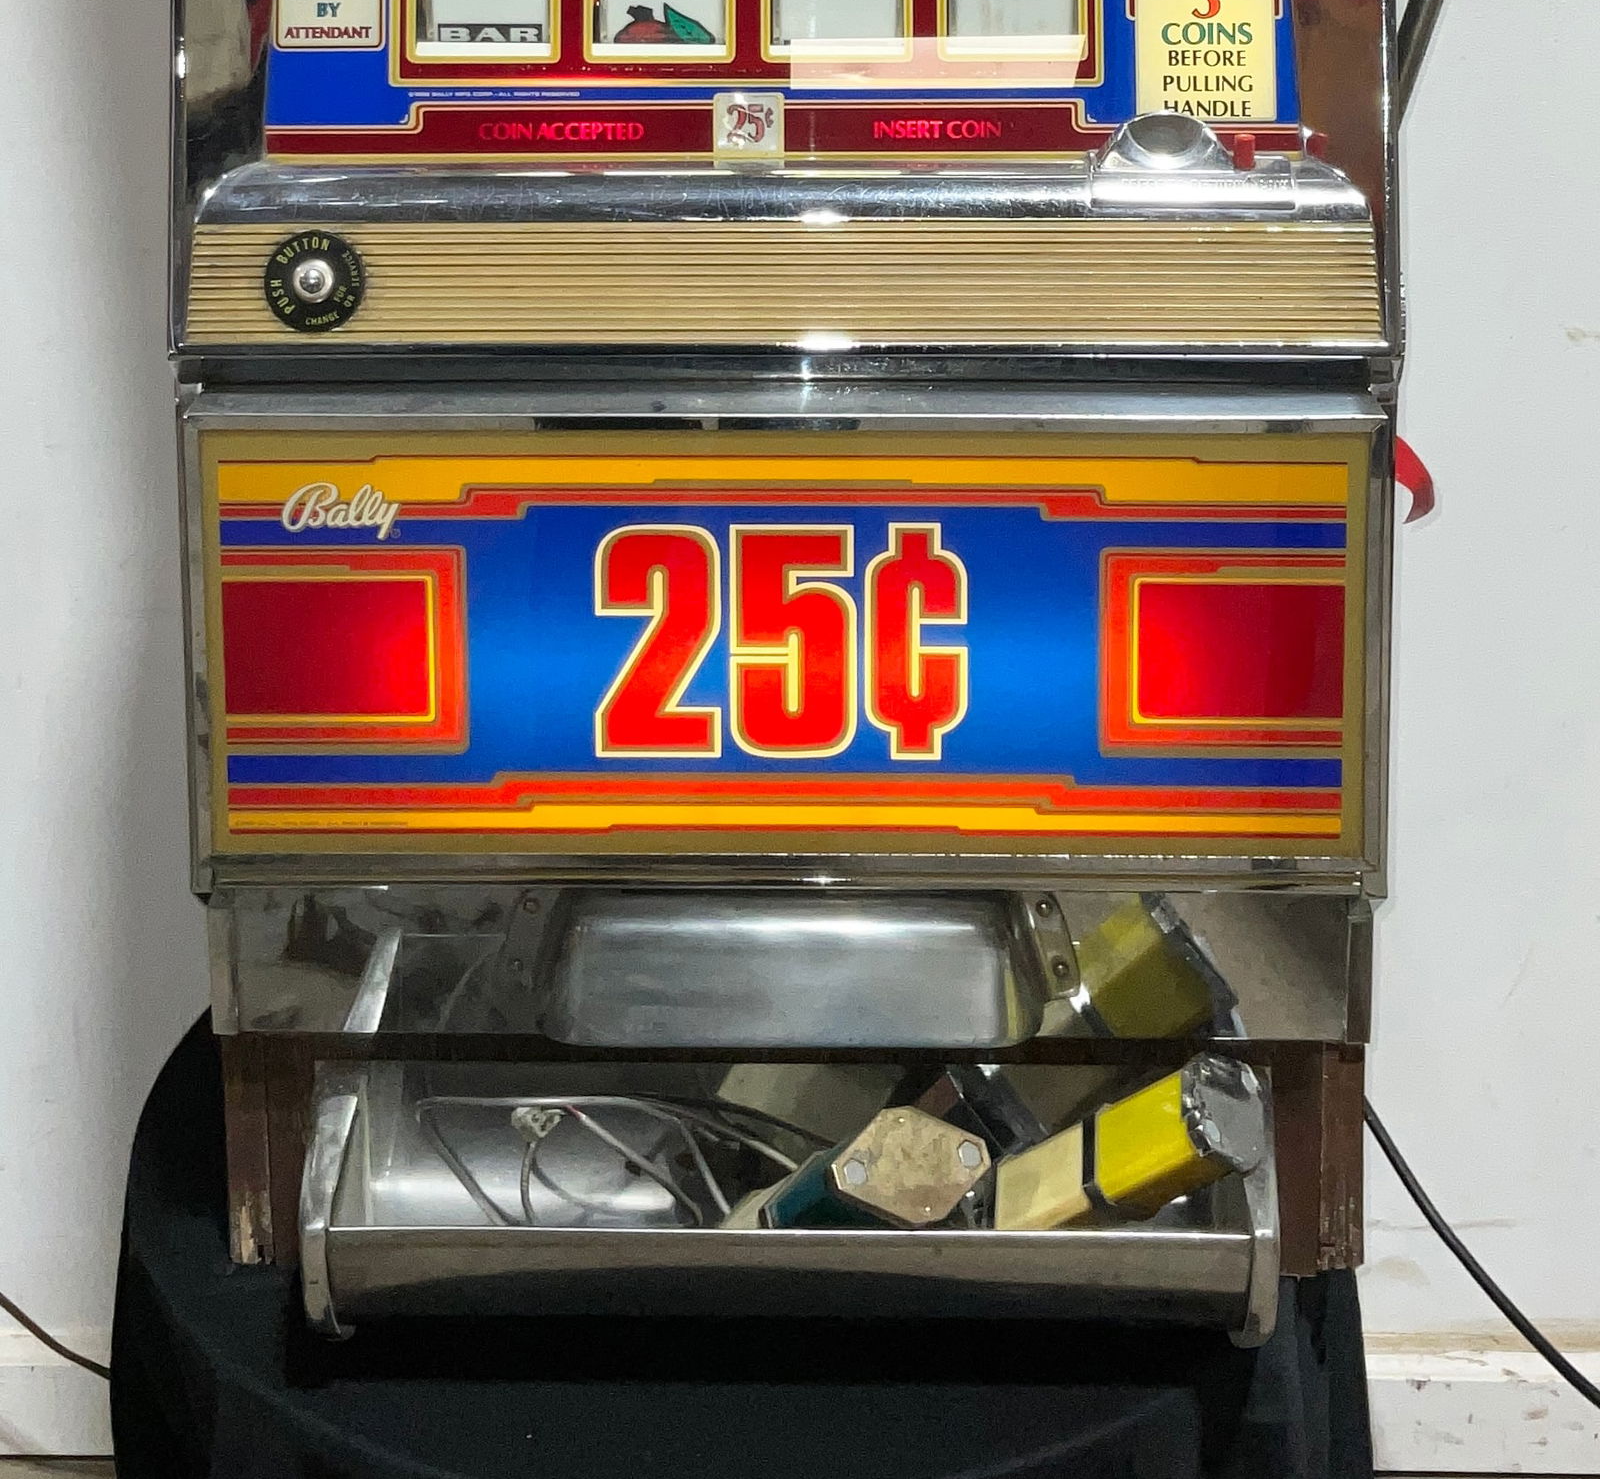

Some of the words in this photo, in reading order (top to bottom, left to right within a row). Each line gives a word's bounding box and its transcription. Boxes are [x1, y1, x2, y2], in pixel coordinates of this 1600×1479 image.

[316, 2, 342, 18] BY
[284, 26, 372, 39] ATTENDANT
[440, 25, 540, 42] BAR
[1161, 22, 1253, 45] COINS
[1168, 49, 1246, 67] BEFORE
[1163, 75, 1253, 92] PULLING
[1163, 100, 1252, 118] HANDLE
[479, 122, 536, 141] COIN
[540, 122, 644, 141] ACCEPTED
[873, 119, 943, 139] INSERT
[947, 119, 1002, 139] COIN
[276, 236, 330, 264] BUTTON
[342, 249, 360, 287] SERVICE
[270, 279, 296, 315] PUSH
[333, 285, 348, 303] FOR
[343, 294, 356, 308] OR
[305, 310, 340, 326] CHANGE
[281, 481, 400, 540] Bally
[594, 522, 969, 760] 25¢
